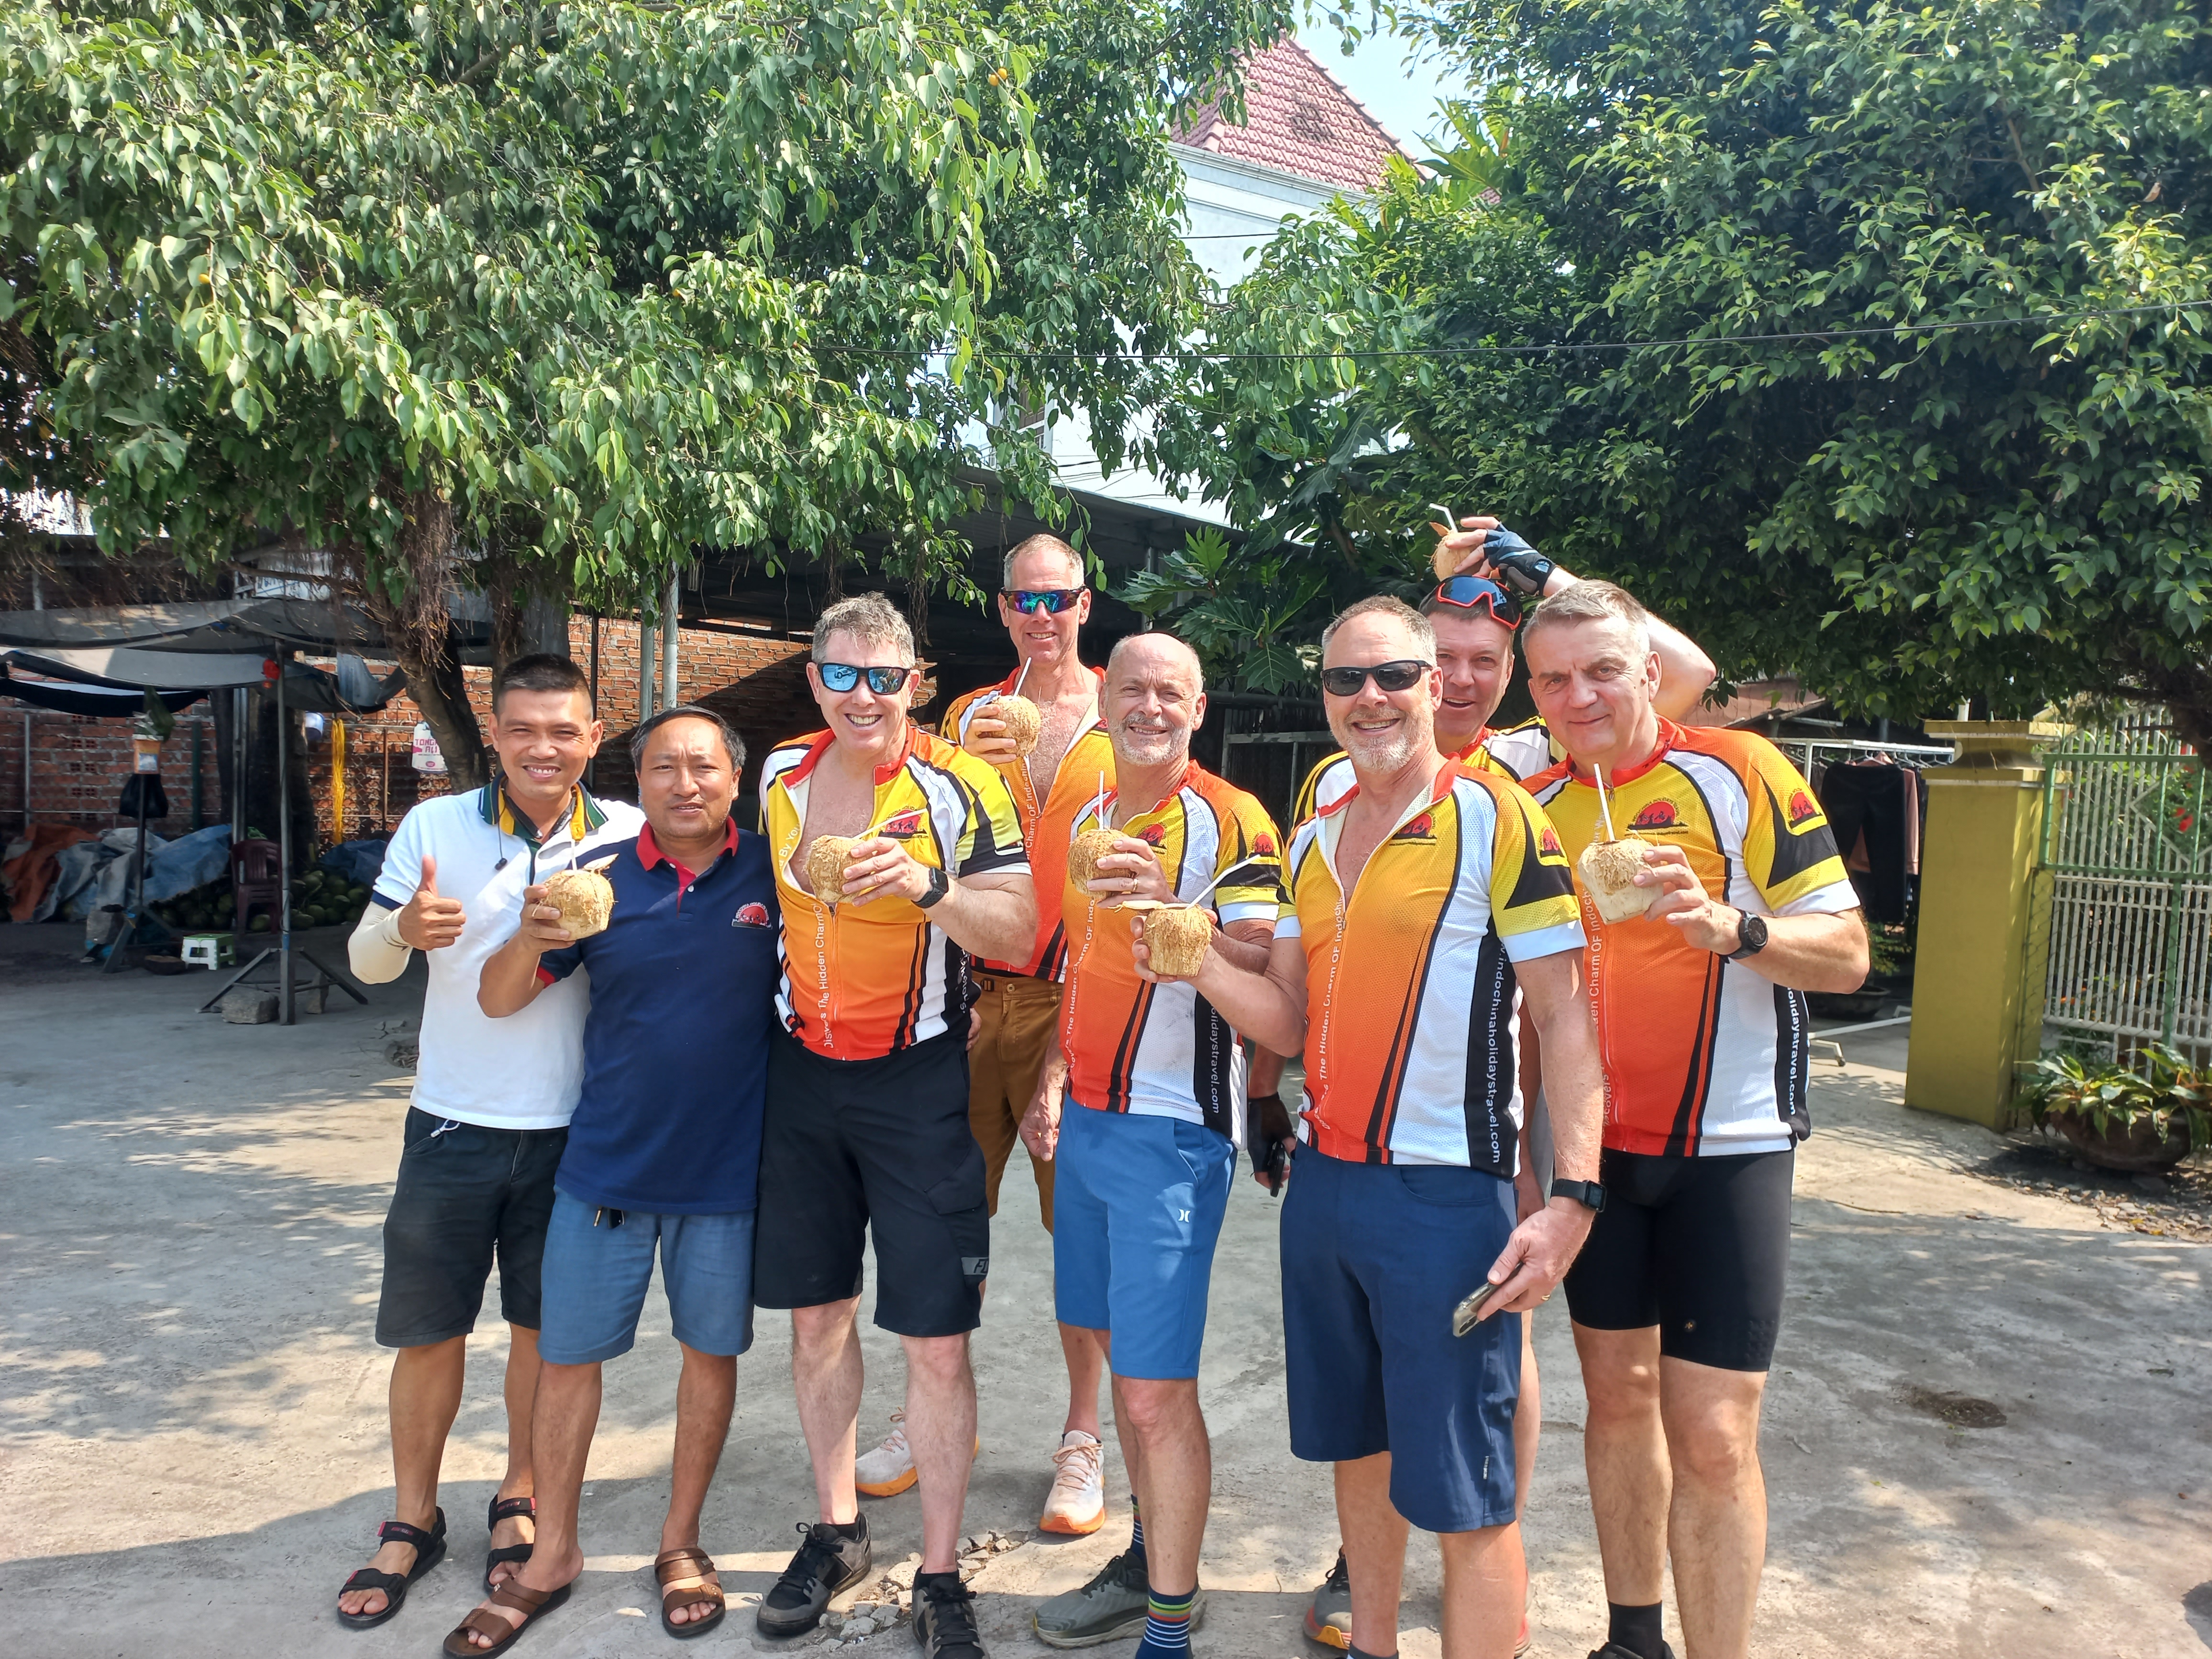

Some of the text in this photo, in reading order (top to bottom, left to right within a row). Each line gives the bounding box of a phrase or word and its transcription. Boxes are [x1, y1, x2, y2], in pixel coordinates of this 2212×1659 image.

[1020, 759, 1033, 802] Indochin
[1027, 803, 1036, 818] OF
[1025, 818, 1036, 849] Charm
[779, 843, 792, 857] By
[1087, 897, 1095, 925] Indo
[815, 915, 825, 948] Charm
[1085, 927, 1093, 940] OF
[1591, 935, 1602, 952] OF
[818, 951, 829, 990] Hidden
[1073, 943, 1090, 973] Charm
[1589, 954, 1600, 997] Charm
[818, 992, 830, 1010] The
[1069, 977, 1078, 1015] Hidden
[1319, 1010, 1330, 1054] Hidden
[1331, 946, 1340, 963] OF
[1066, 1017, 1074, 1037] The
